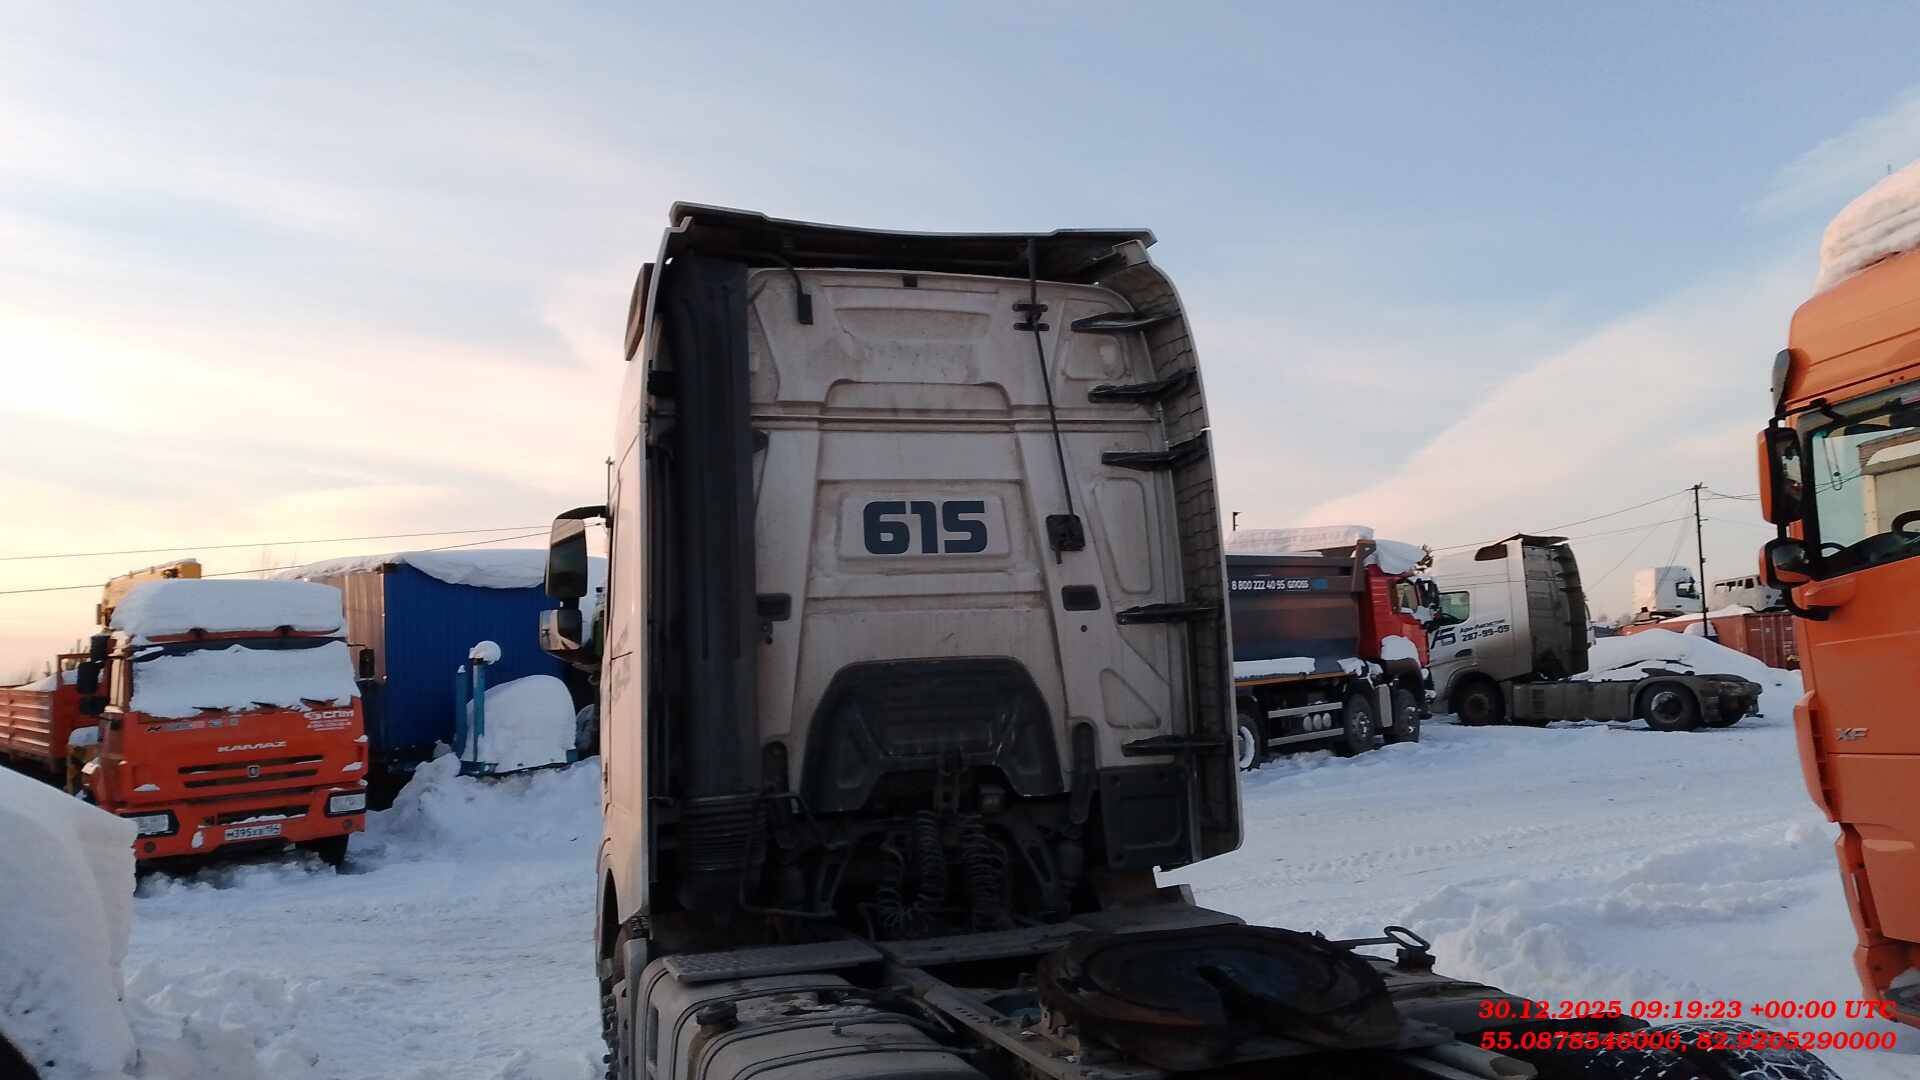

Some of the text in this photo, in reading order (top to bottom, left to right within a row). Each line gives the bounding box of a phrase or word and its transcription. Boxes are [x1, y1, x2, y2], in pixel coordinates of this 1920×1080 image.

[863, 500, 988, 555] 615
[1231, 580, 1238, 590] 8
[1238, 580, 1253, 590] 800
[1253, 580, 1266, 590] 222
[1835, 727, 1869, 741] XF
